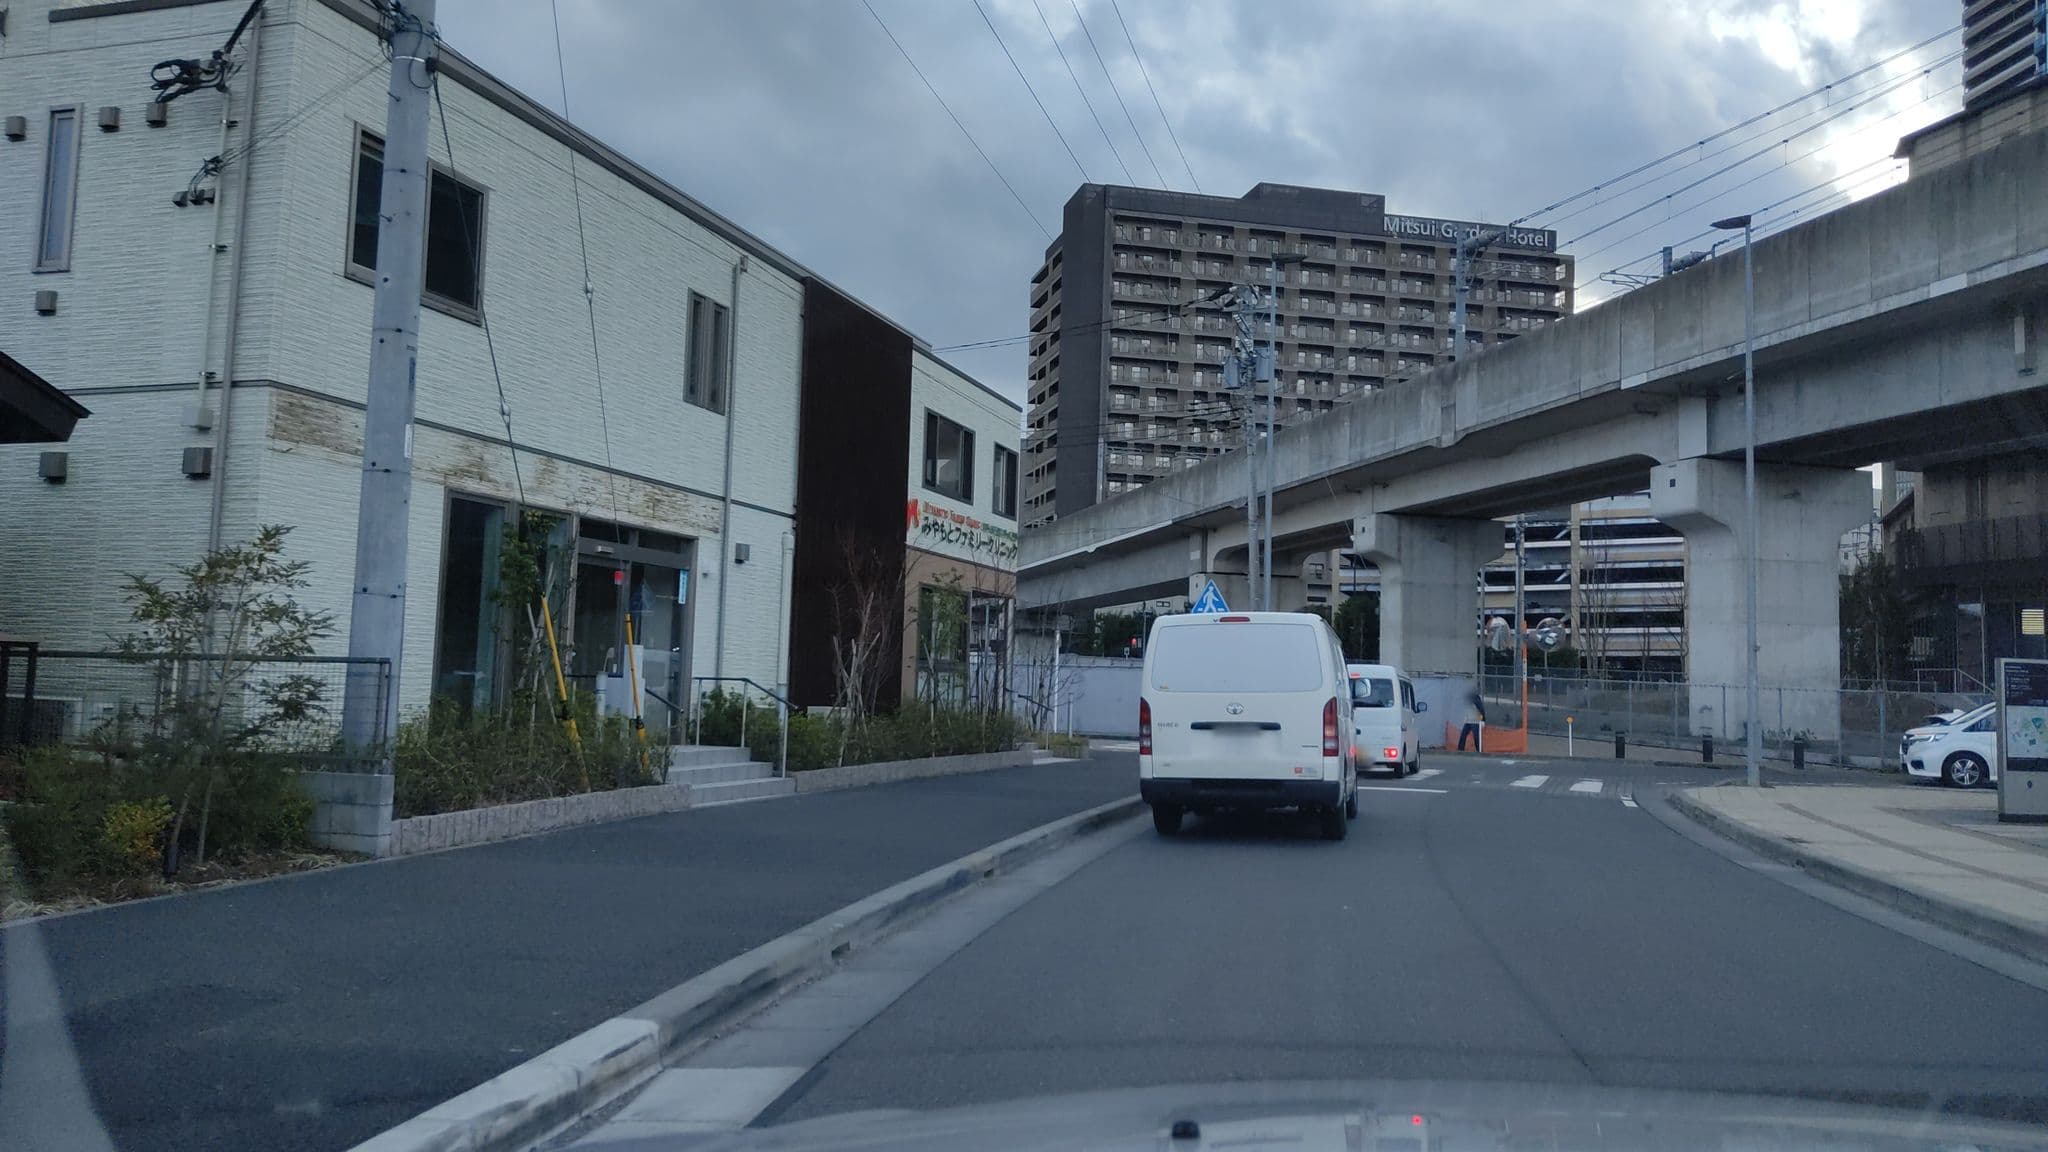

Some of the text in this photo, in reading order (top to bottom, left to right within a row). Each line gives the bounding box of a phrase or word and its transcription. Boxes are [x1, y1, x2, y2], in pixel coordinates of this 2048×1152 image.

[1383, 216, 1548, 247] Mitsui Grde Hotel
